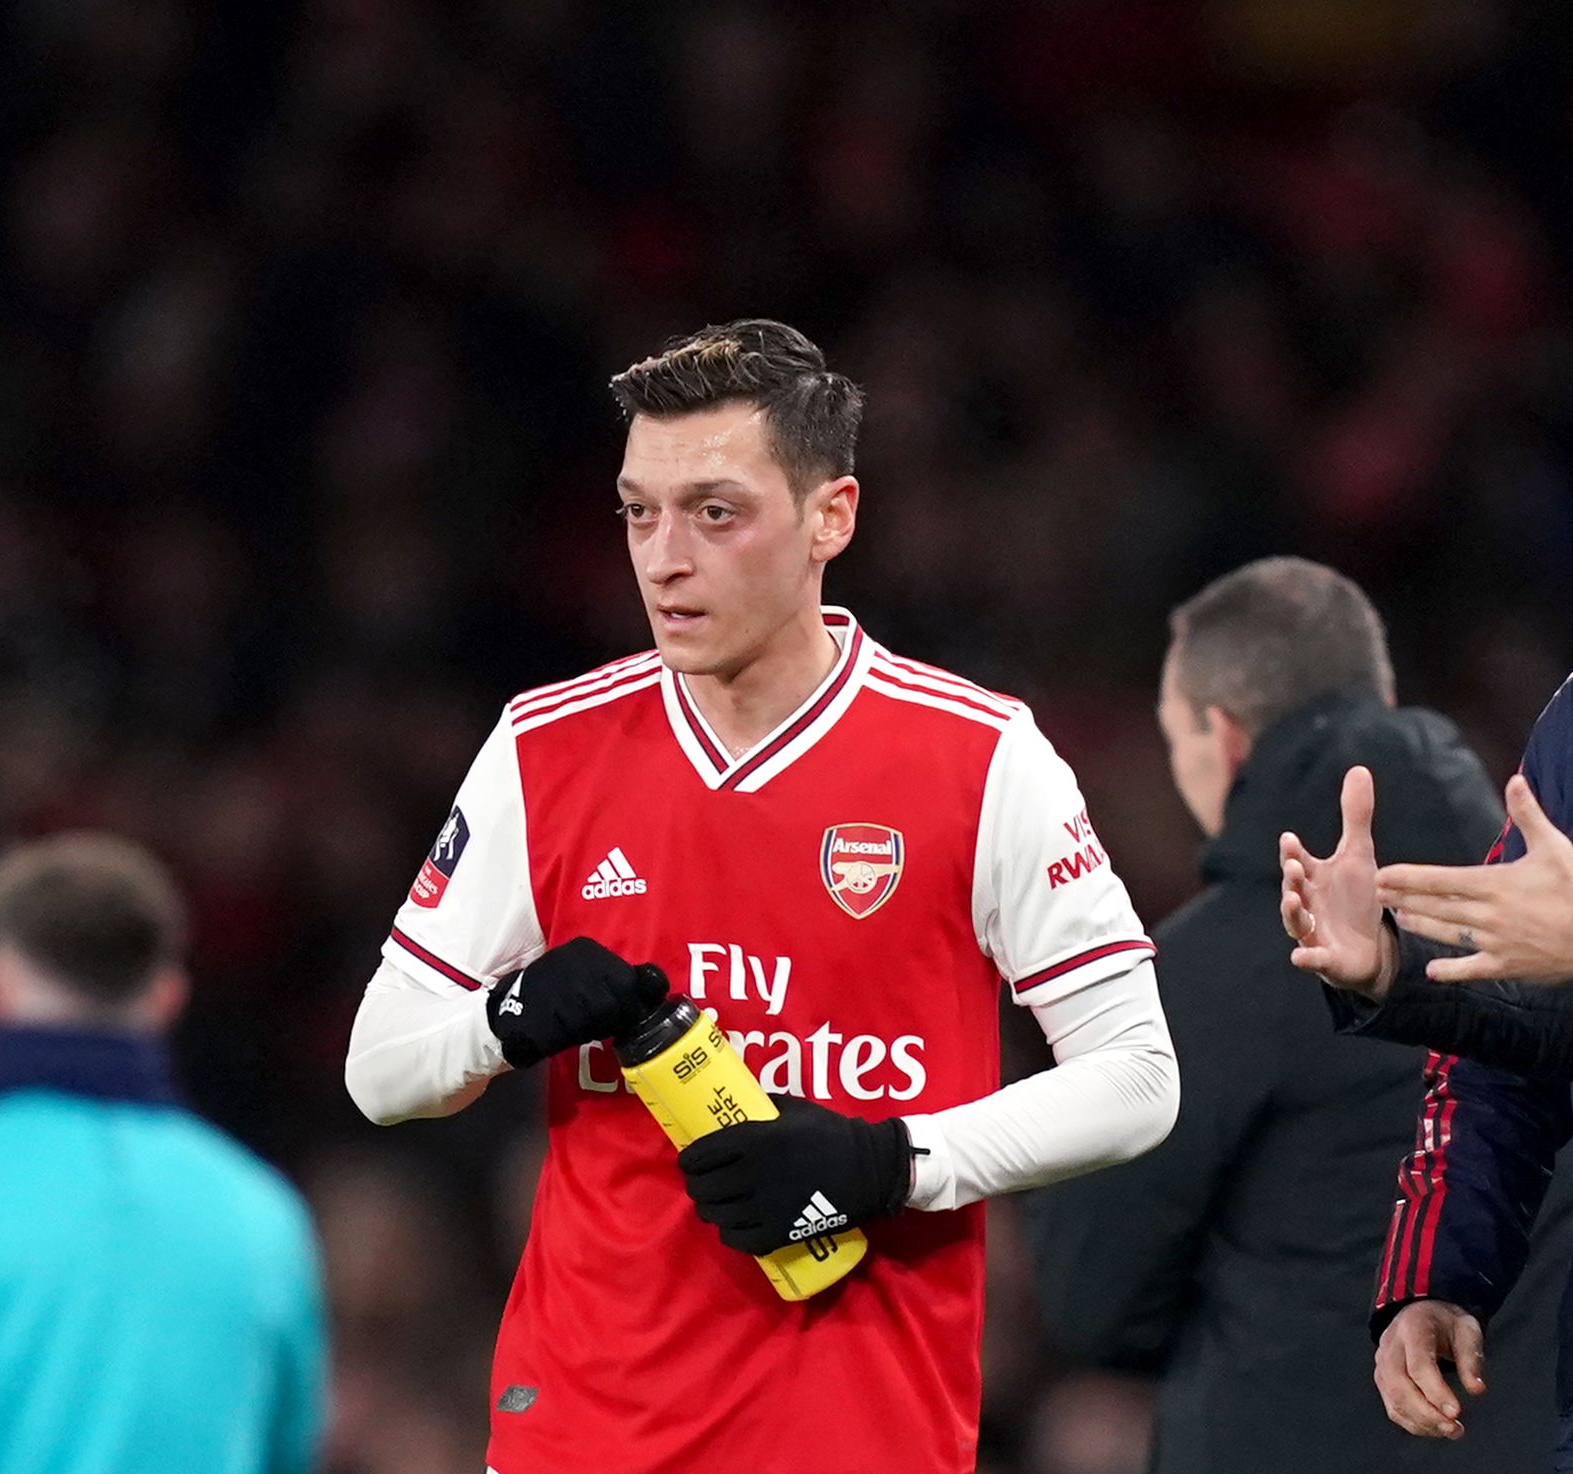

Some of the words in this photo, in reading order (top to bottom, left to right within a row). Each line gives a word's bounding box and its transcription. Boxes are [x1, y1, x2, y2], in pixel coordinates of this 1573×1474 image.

[832, 838, 892, 855] Arsenal
[581, 878, 647, 901] adidas
[687, 943, 792, 1015] Fly
[789, 1214, 848, 1241] adidas
